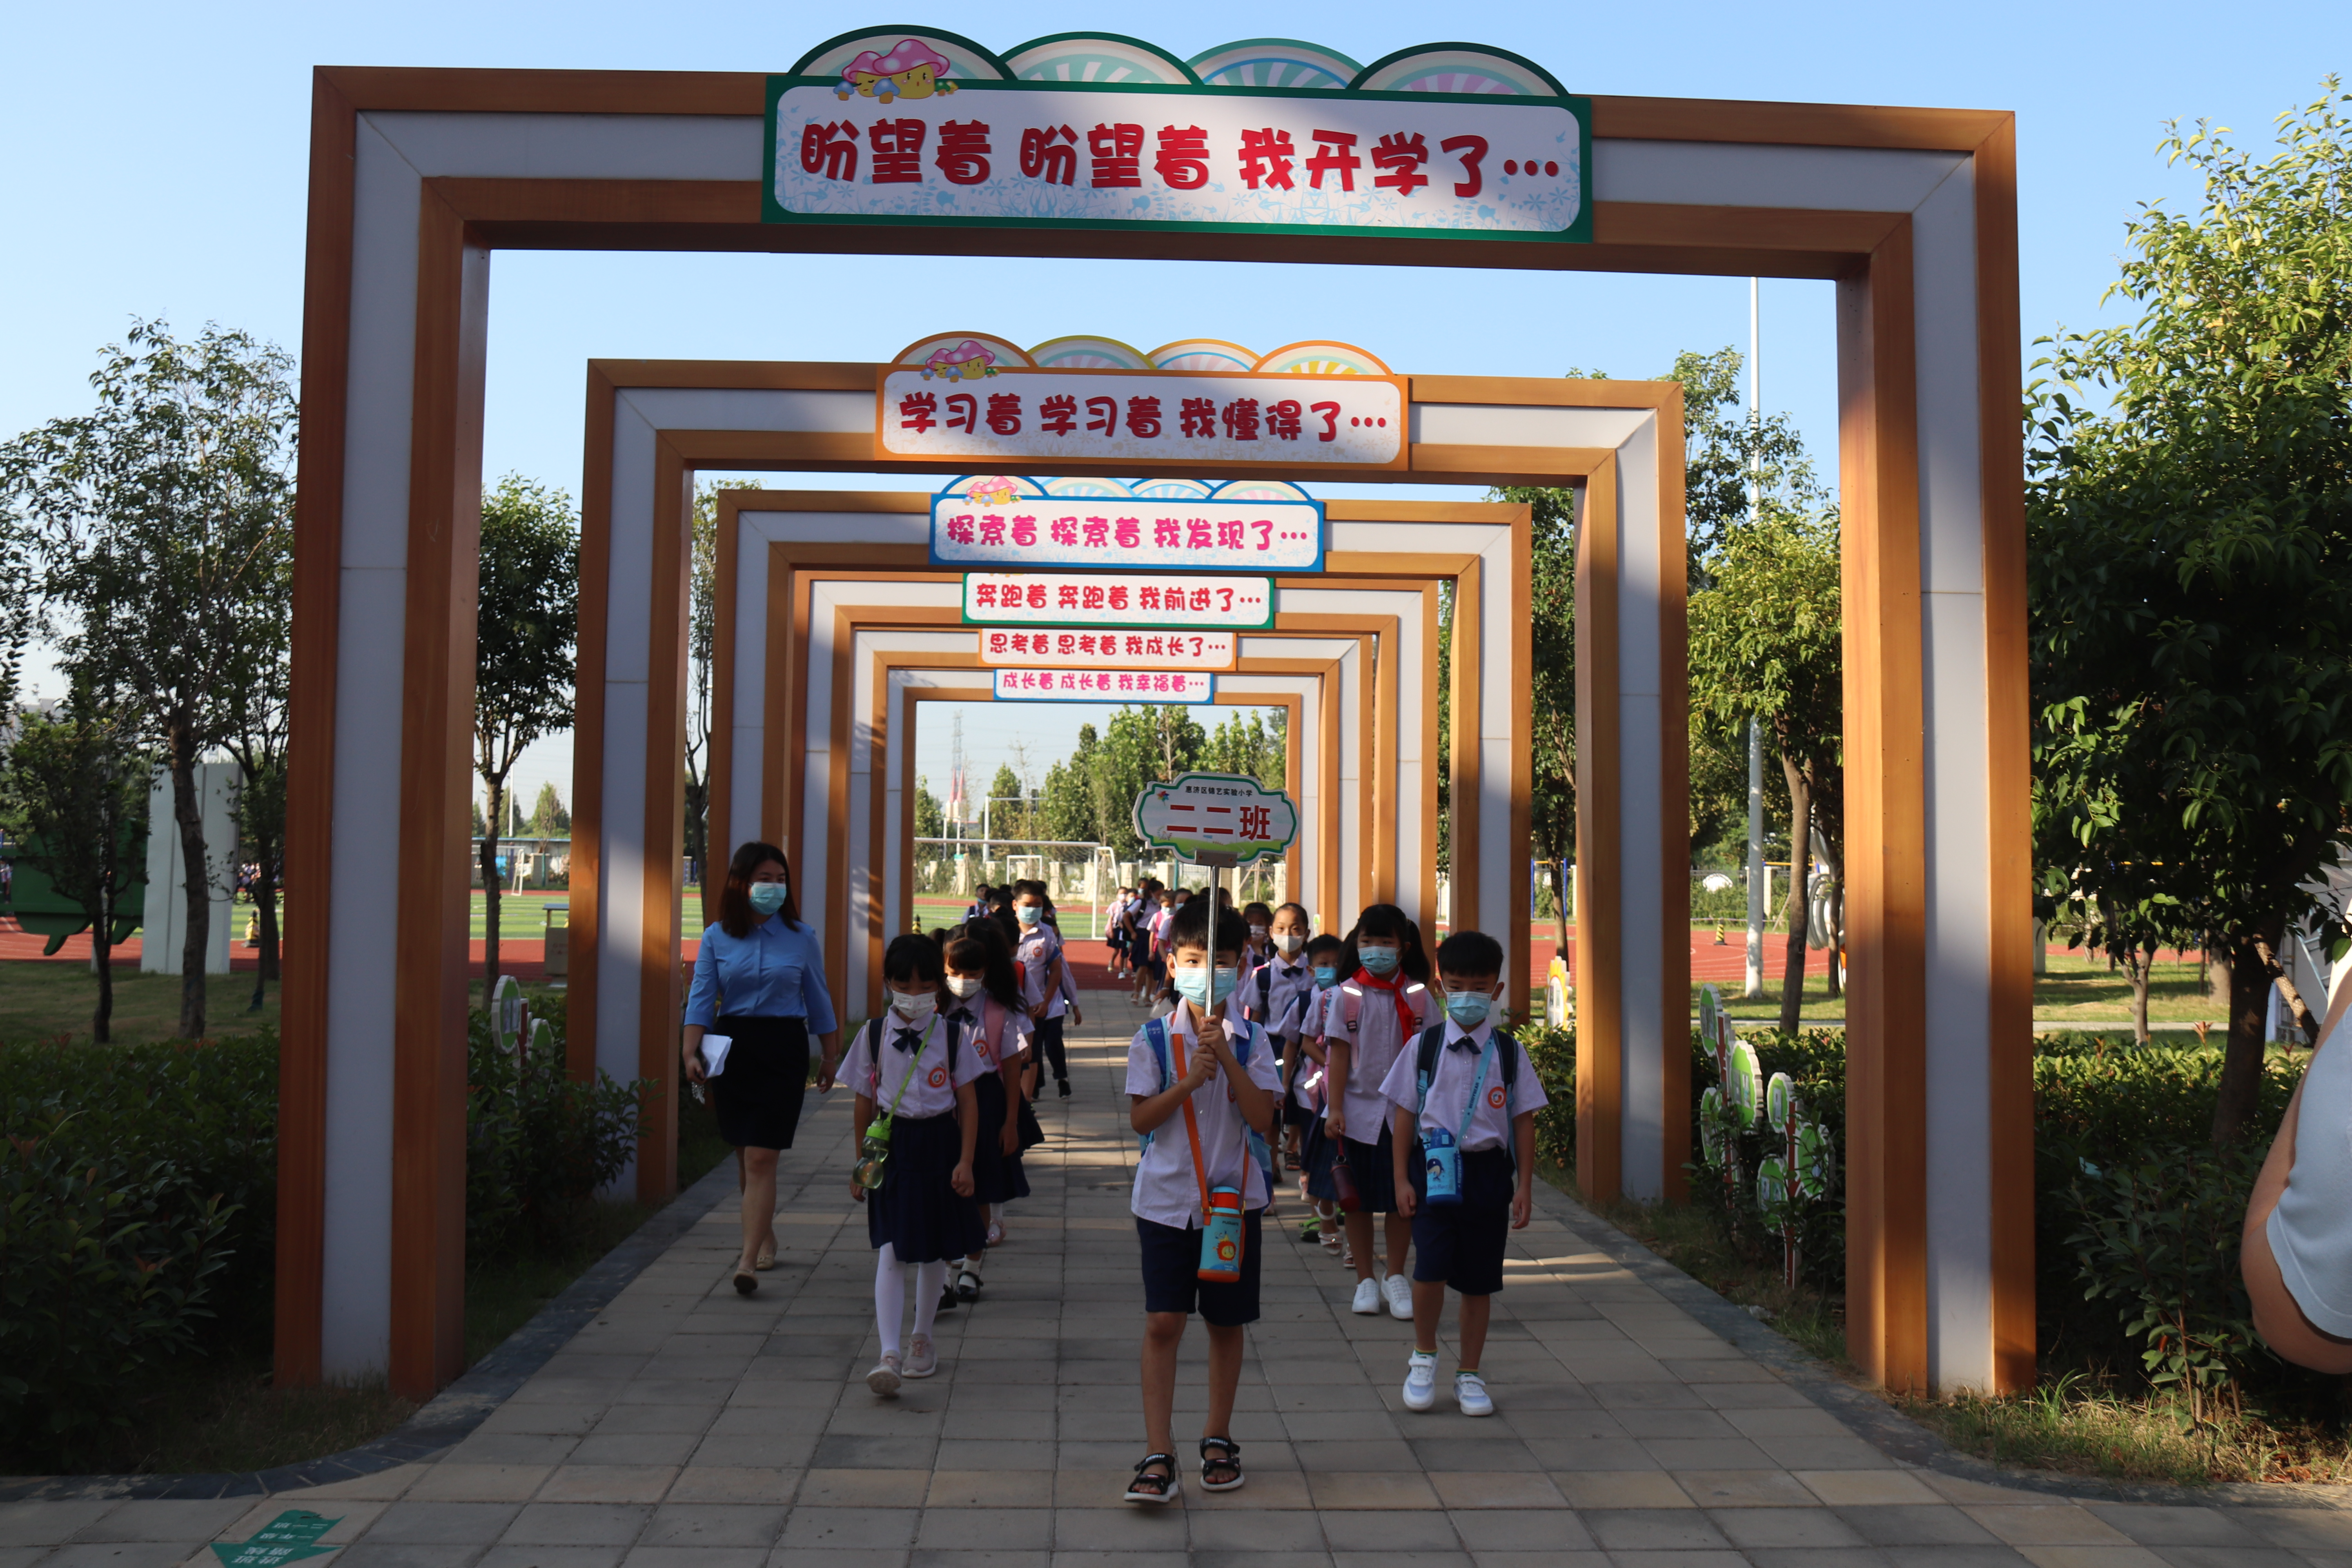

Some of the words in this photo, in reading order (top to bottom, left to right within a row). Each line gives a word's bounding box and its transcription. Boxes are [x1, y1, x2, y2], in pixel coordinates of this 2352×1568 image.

[802, 119, 991, 185] 盼望着
[1021, 123, 1210, 191] 盼望着
[900, 392, 1022, 435] 学习着
[1040, 395, 1161, 438] 学习着
[947, 514, 1038, 547] 探索着
[1051, 516, 1141, 549] 探索着
[976, 583, 1047, 610] 奔跑着
[1058, 585, 1129, 611] 奔跑着
[990, 633, 1050, 655] 思考着
[1058, 634, 1117, 656] 思考着
[1003, 672, 1054, 691] 成长着
[1061, 673, 1111, 691] 成长着
[1185, 786, 1253, 797] 惠济区锦艺实验小学
[1167, 805, 1271, 840] 二二班
